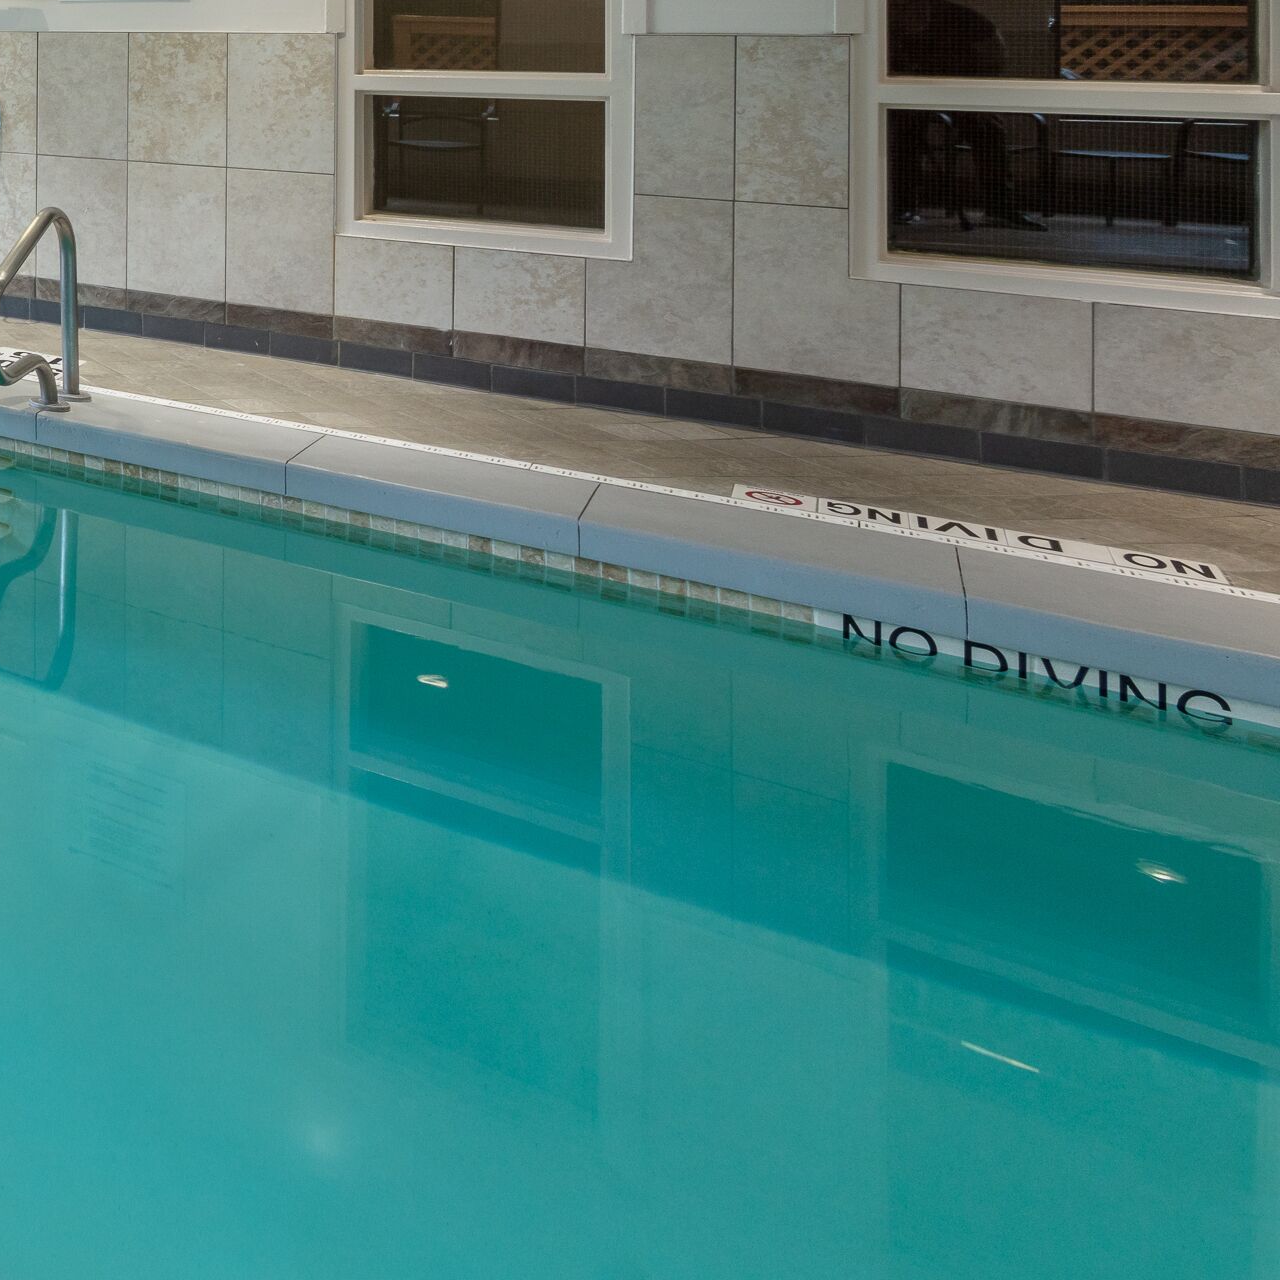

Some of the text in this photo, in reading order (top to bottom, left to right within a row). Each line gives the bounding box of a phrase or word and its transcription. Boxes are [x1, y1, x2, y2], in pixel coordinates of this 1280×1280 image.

[826, 500, 1216, 580] NO DIVING
[842, 613, 1233, 726] NO DIVING
